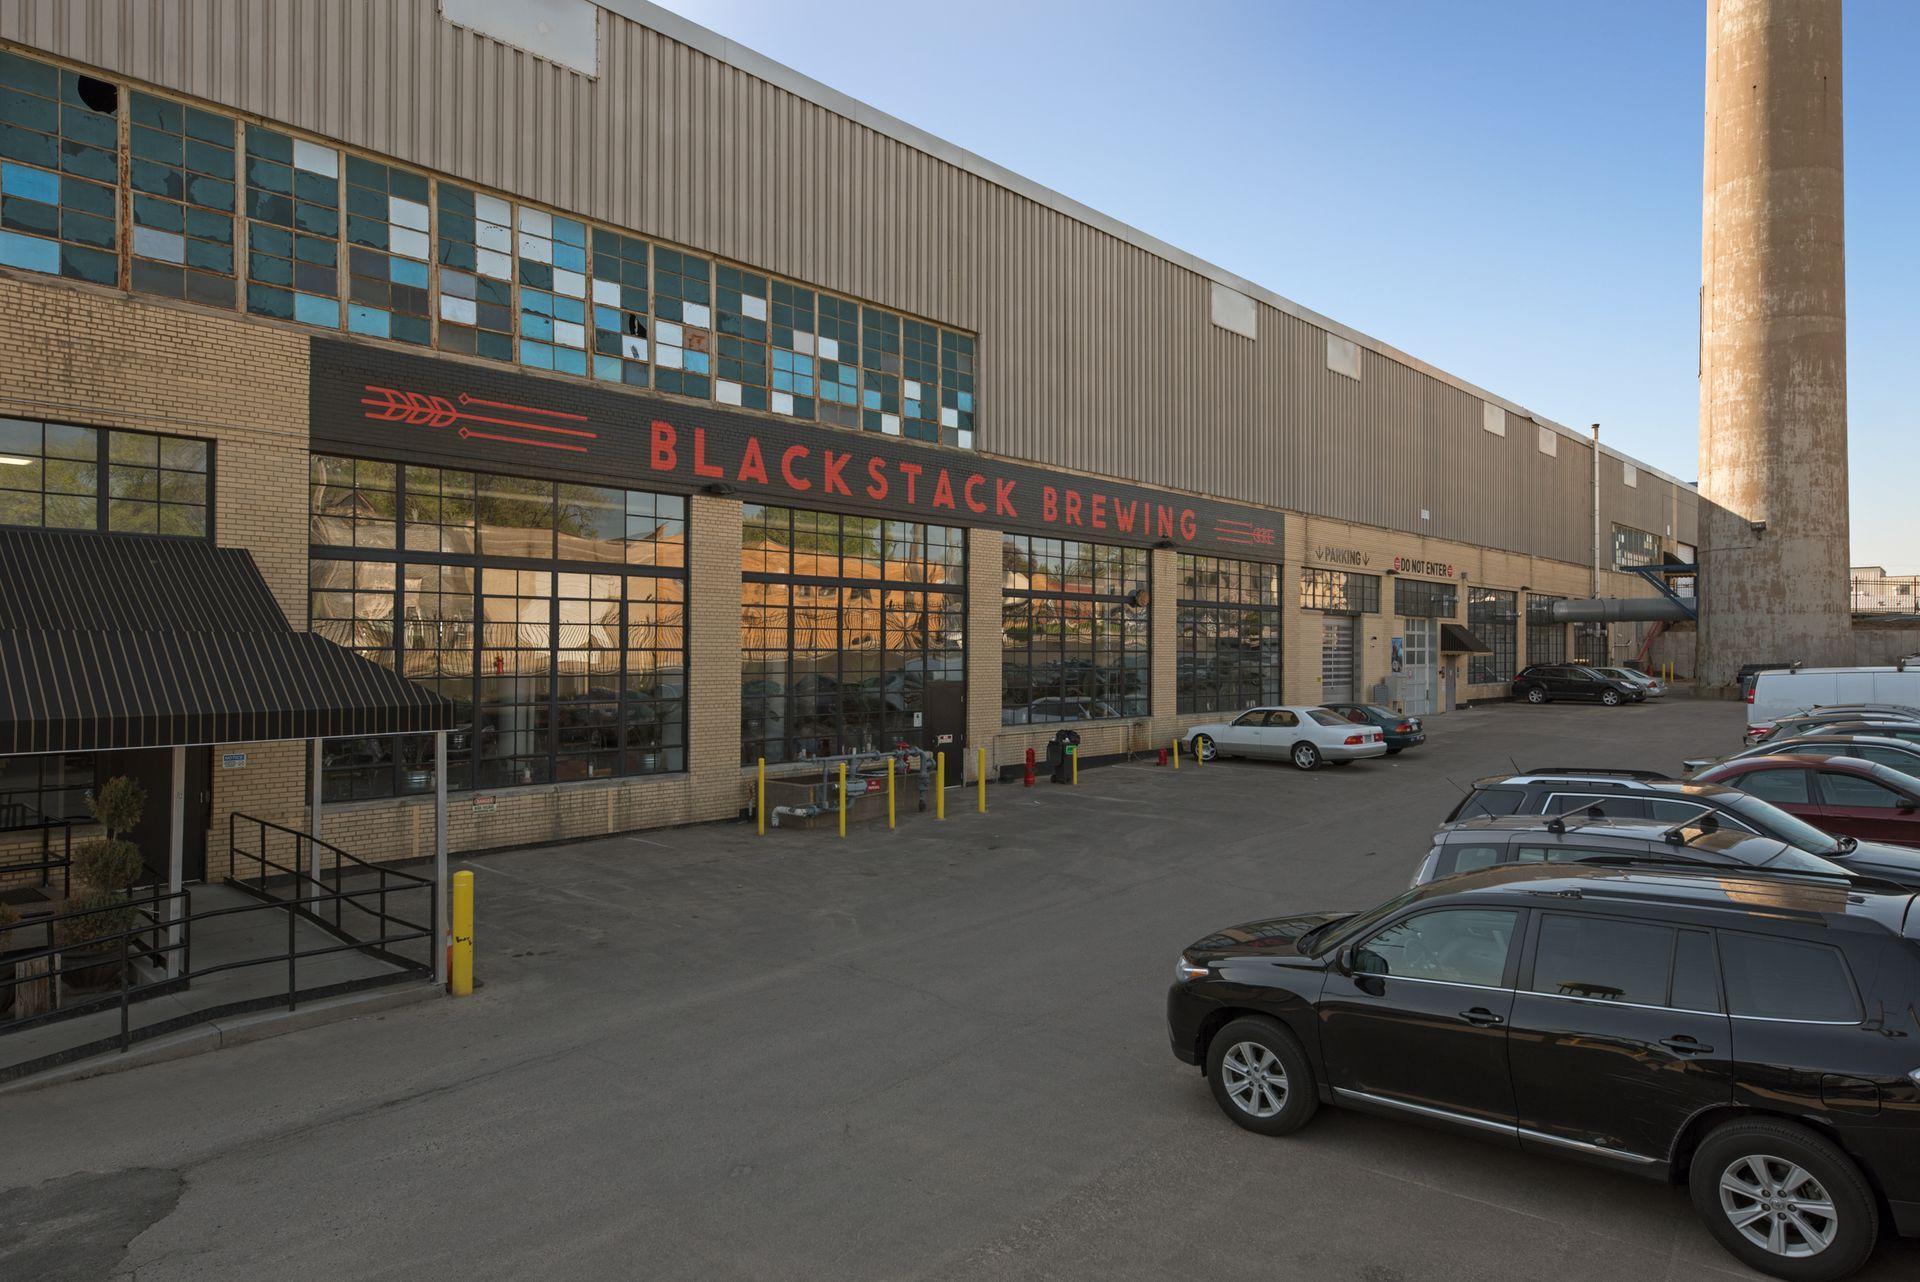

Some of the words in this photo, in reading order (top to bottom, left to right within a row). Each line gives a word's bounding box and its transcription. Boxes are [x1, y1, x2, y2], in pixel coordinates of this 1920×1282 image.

[650, 419, 1018, 518] BLACKSTACK
[1043, 486, 1197, 541] BREWING
[1325, 546, 1361, 566] PARKING
[1401, 558, 1410, 572] DO
[1412, 559, 1425, 574] NOT
[1426, 561, 1447, 577] ENTER
